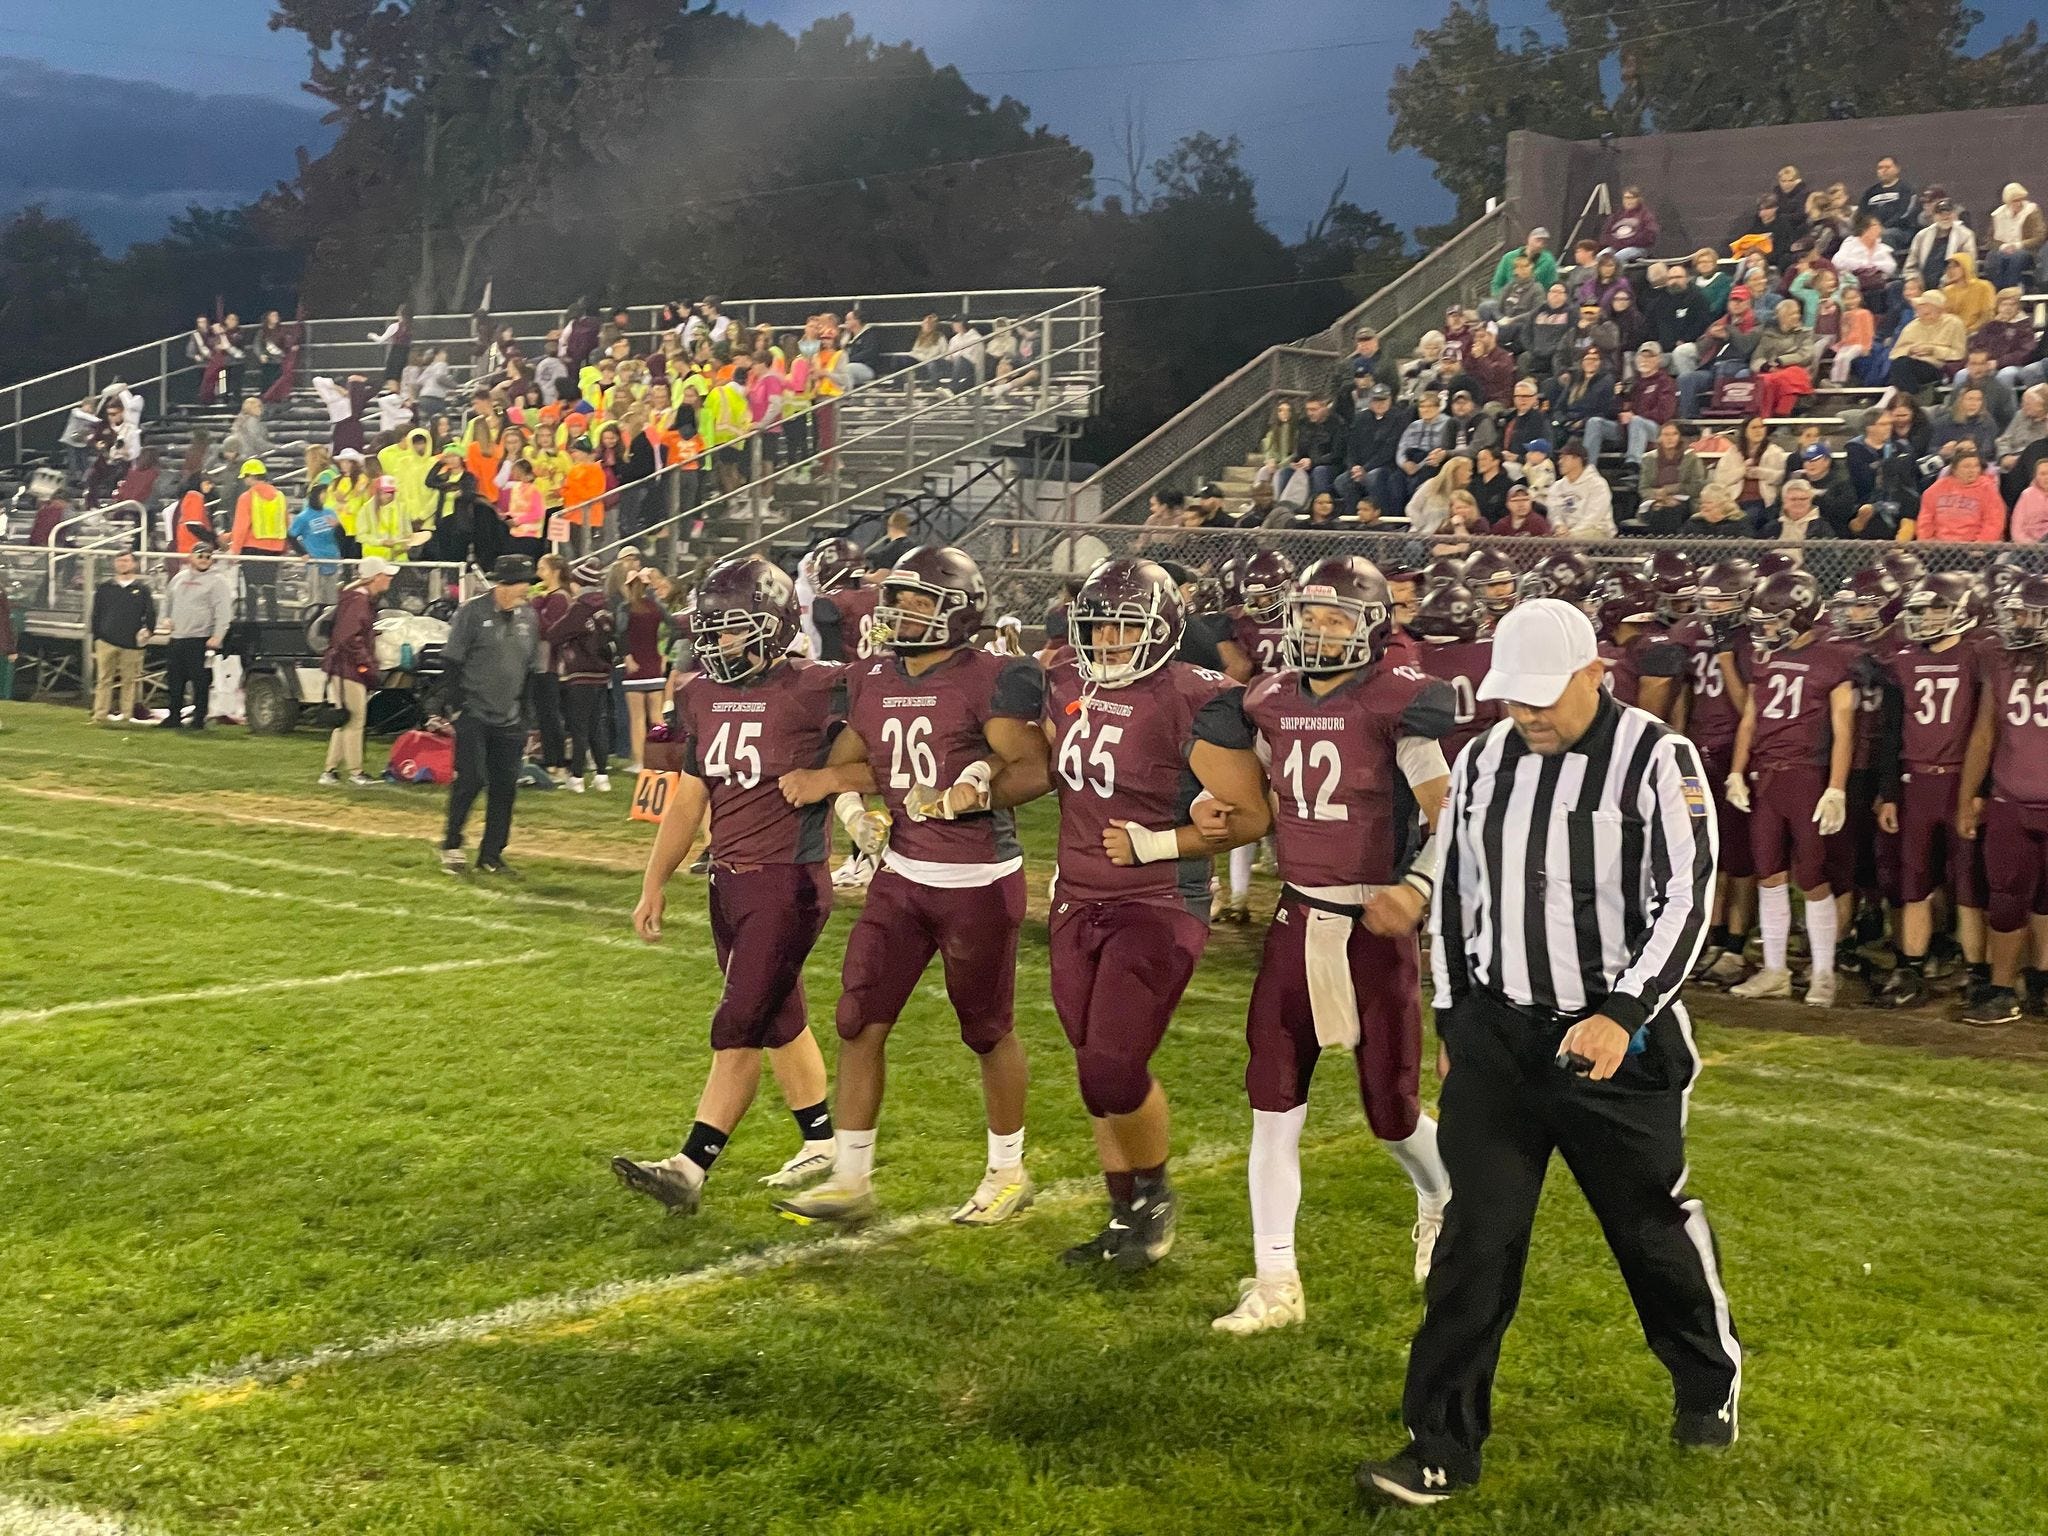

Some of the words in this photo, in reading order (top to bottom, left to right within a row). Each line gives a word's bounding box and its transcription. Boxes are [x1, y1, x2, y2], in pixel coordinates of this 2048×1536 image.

[1280, 717, 1345, 731] SHIPPENSBURG
[1763, 674, 1805, 720] 21
[1913, 677, 1960, 725] 37
[705, 722, 762, 790] 45
[881, 716, 938, 789] 26
[1057, 718, 1124, 799] 65
[1284, 739, 1349, 821] 12
[637, 776, 668, 816] 40
